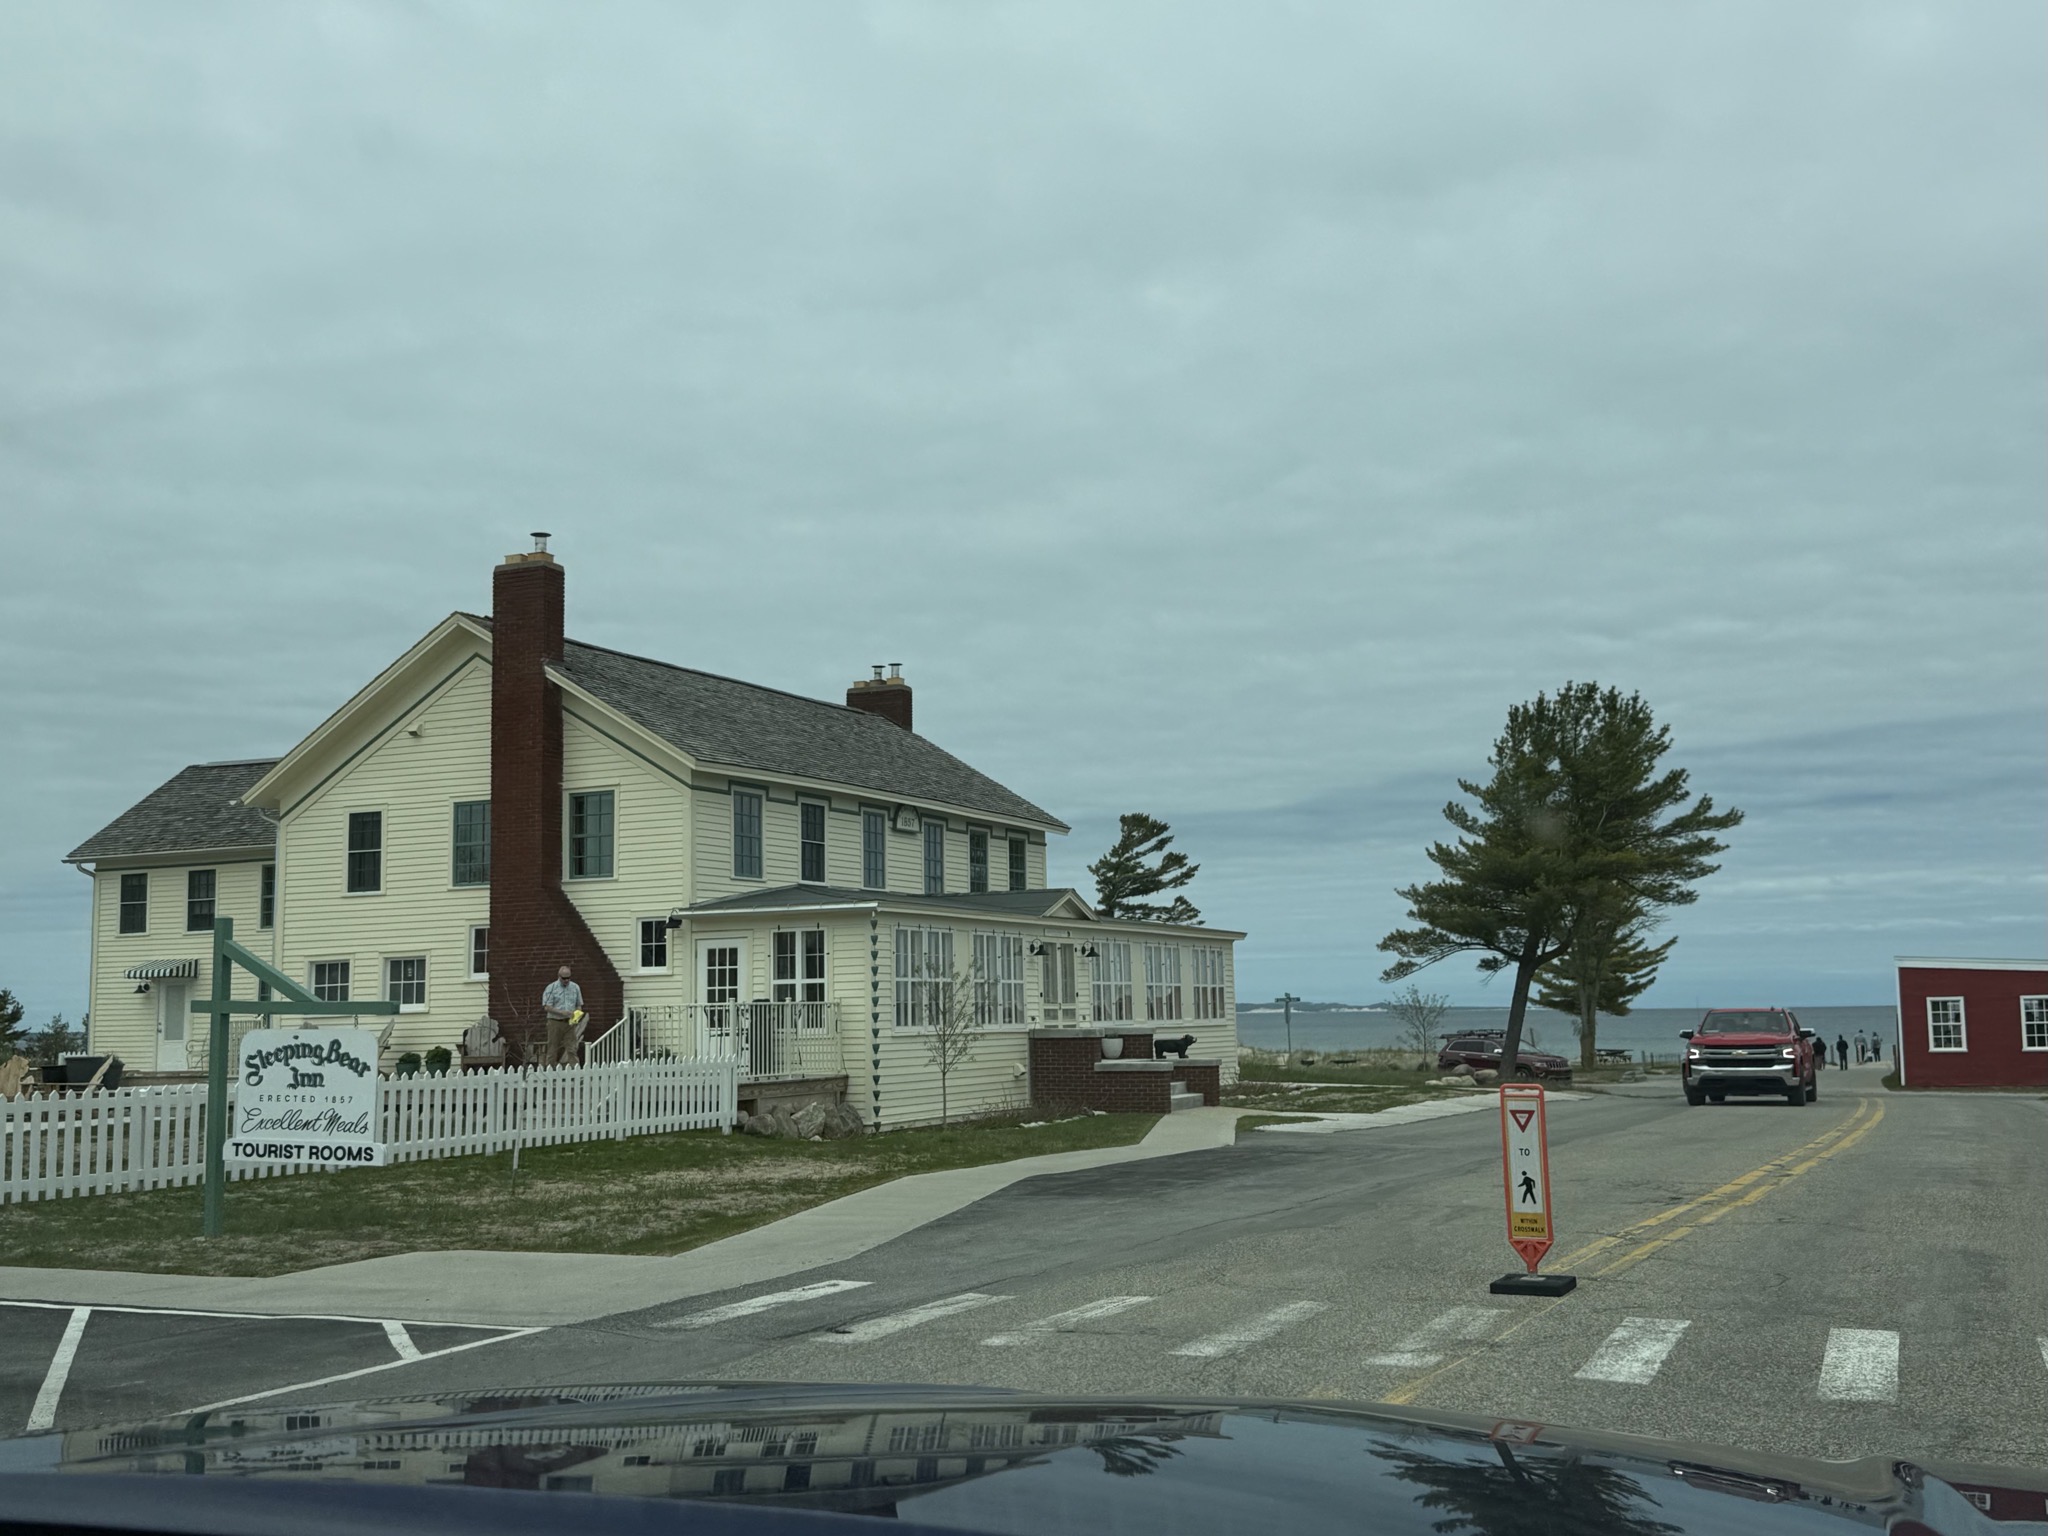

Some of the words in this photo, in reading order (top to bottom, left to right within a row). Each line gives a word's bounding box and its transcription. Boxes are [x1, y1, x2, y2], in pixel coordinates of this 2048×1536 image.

[245, 1035, 325, 1086] Sleeping
[324, 1039, 371, 1077] Bear
[287, 1066, 325, 1089] Inn
[259, 1094, 316, 1103] ERECTED
[325, 1095, 353, 1104] 1857
[241, 1106, 324, 1133] Excellent
[322, 1107, 369, 1136] Meals
[232, 1142, 305, 1159] TOURIST
[308, 1145, 374, 1162] ROOMS
[1519, 1148, 1530, 1156] TO
